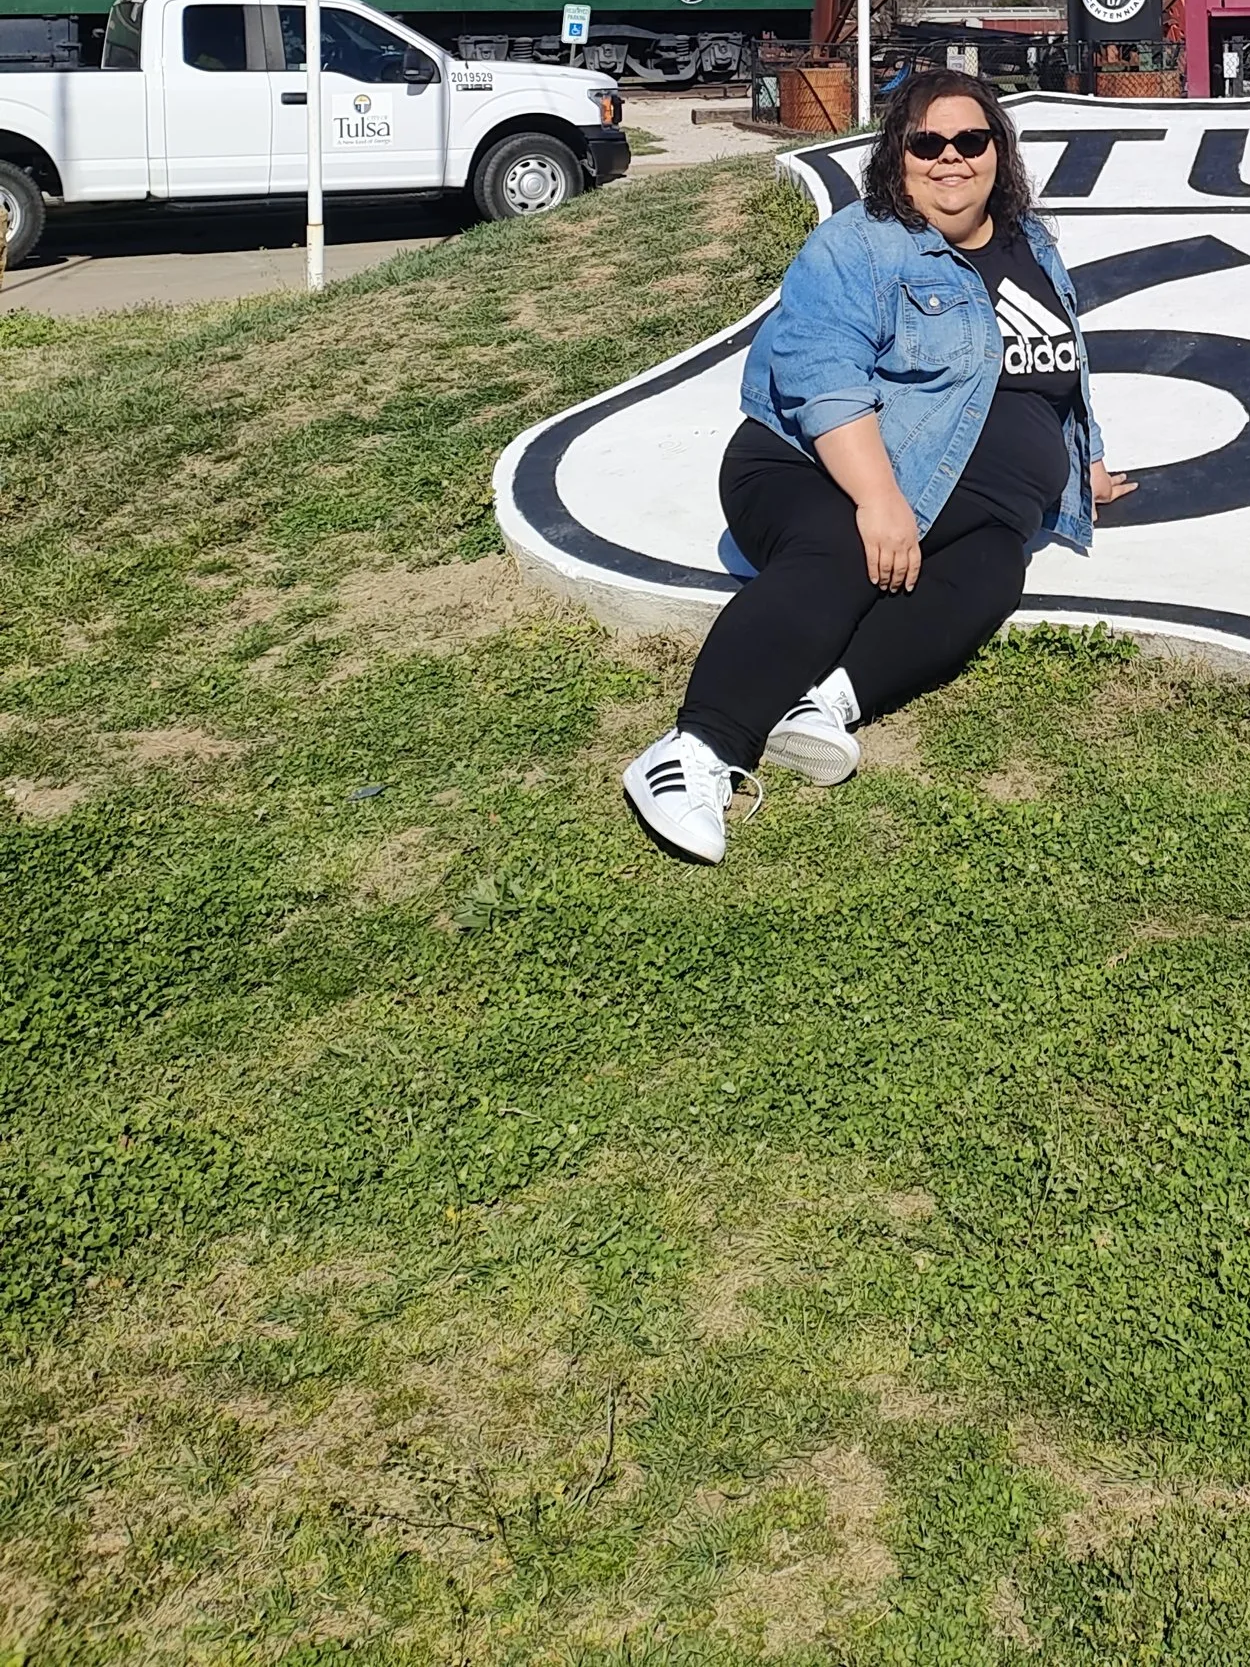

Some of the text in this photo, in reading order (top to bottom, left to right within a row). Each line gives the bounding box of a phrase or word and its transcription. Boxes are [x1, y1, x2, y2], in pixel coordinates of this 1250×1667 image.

[451, 72, 493, 82] 2019529
[333, 117, 391, 138] Tulsa
[1004, 335, 1080, 374] dida
